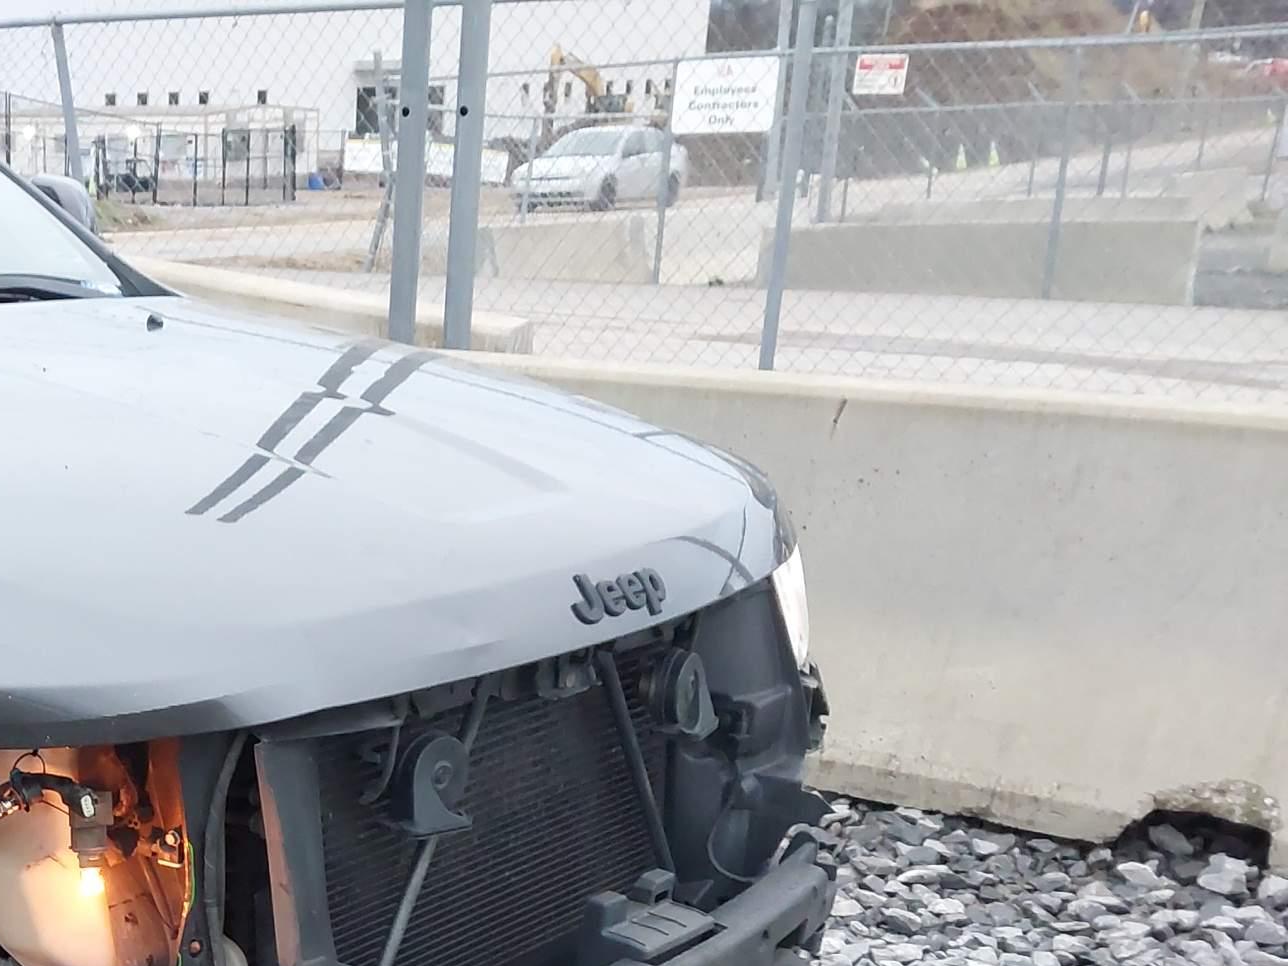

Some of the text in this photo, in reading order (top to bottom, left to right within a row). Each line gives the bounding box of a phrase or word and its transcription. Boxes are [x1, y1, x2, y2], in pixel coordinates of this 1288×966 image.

[694, 85, 757, 97] Employees
[688, 99, 759, 111] Contractors
[708, 114, 734, 125] Only
[571, 568, 666, 625] Jeep
